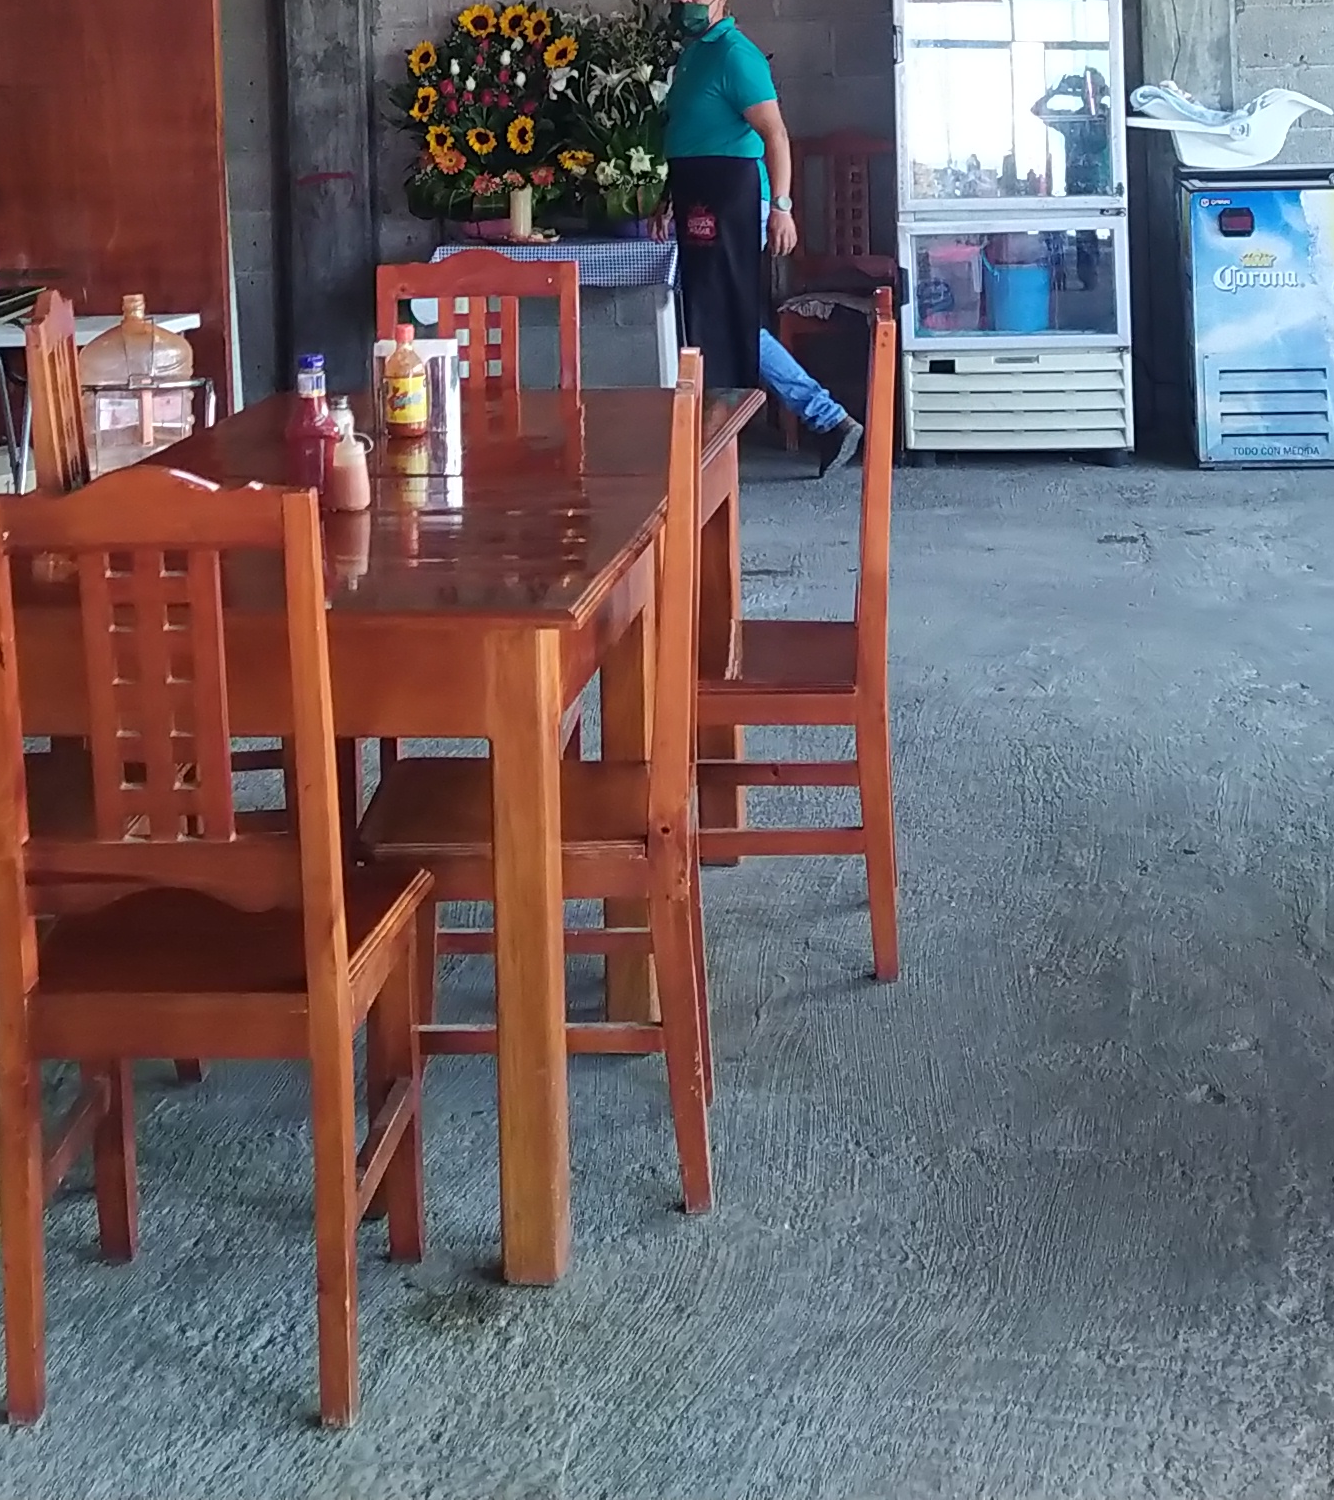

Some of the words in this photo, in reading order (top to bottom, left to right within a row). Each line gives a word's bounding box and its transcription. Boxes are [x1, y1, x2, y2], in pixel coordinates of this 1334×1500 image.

[1213, 265, 1299, 293] Corona
[1233, 447, 1258, 456] TODO
[1260, 447, 1281, 456] CON
[1283, 446, 1320, 456] MEDIDA
